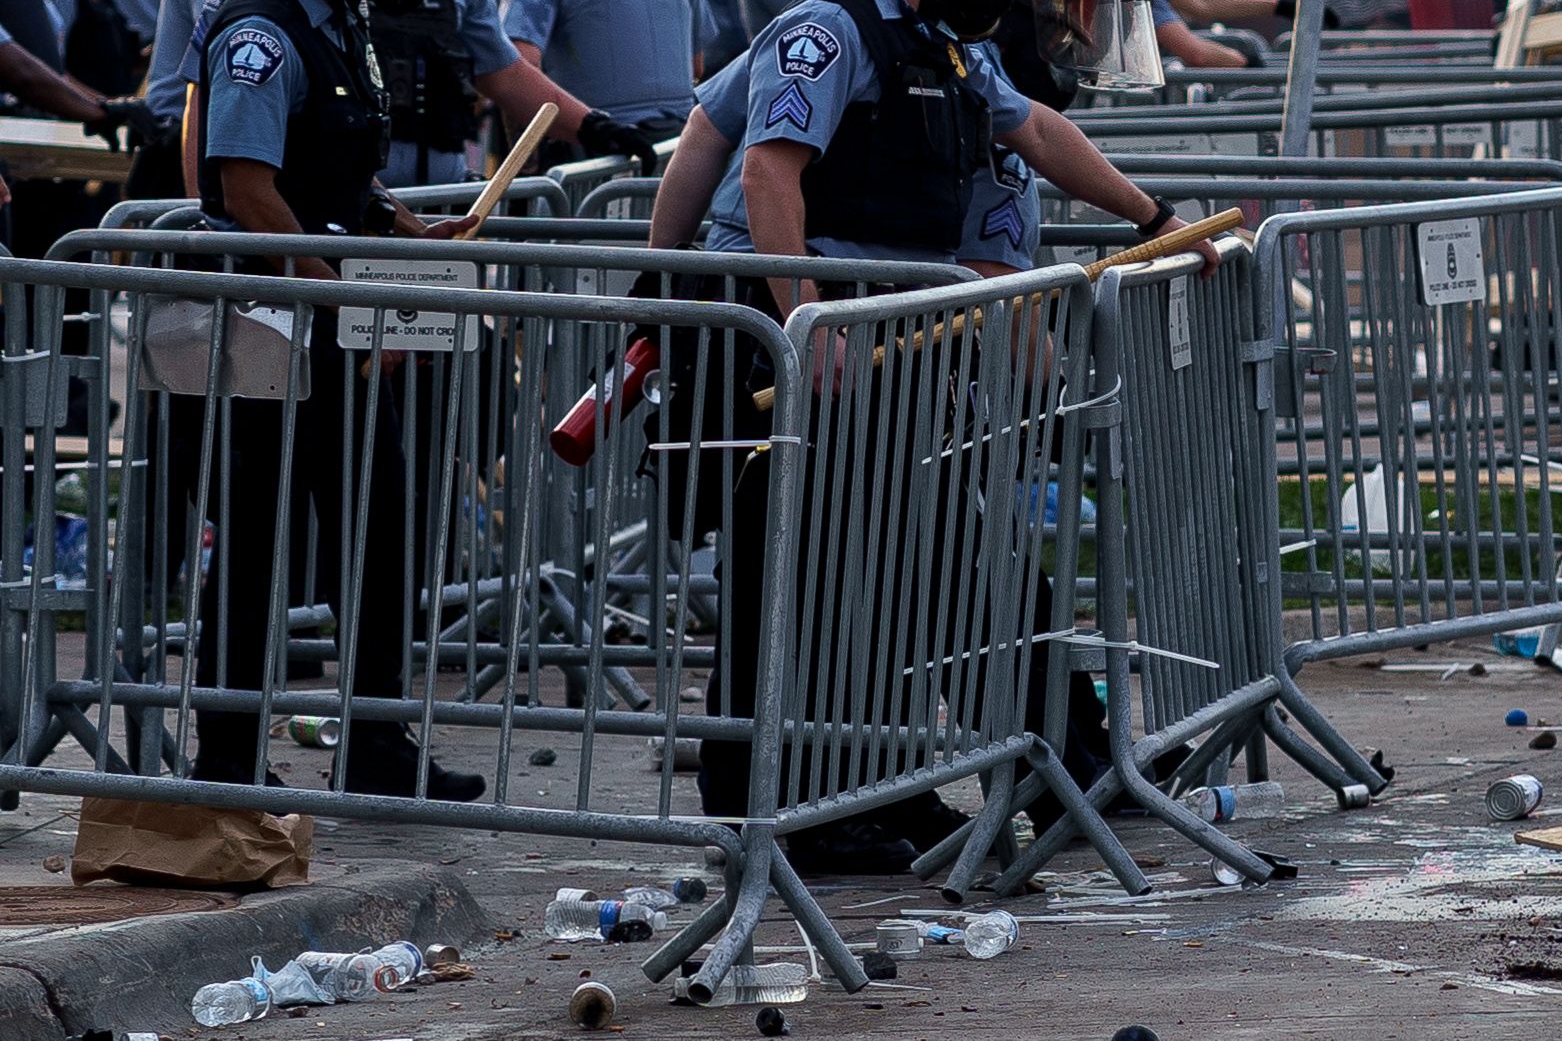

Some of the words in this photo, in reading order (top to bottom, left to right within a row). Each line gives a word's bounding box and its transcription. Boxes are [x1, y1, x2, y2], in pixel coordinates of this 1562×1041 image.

[229, 33, 282, 57] MINNEAPOLIS
[783, 26, 836, 53] MINNEAPOLIS
[232, 68, 261, 81] POLICE
[786, 62, 815, 75] POLICE
[355, 272, 395, 280] MINNEAPOLIS
[396, 272, 416, 281] POLICE
[418, 273, 458, 282] DEPARTMENT
[351, 324, 374, 335] POLIC
[404, 326, 416, 336] DO
[418, 326, 434, 336] NOT
[436, 326, 456, 336] CRO
